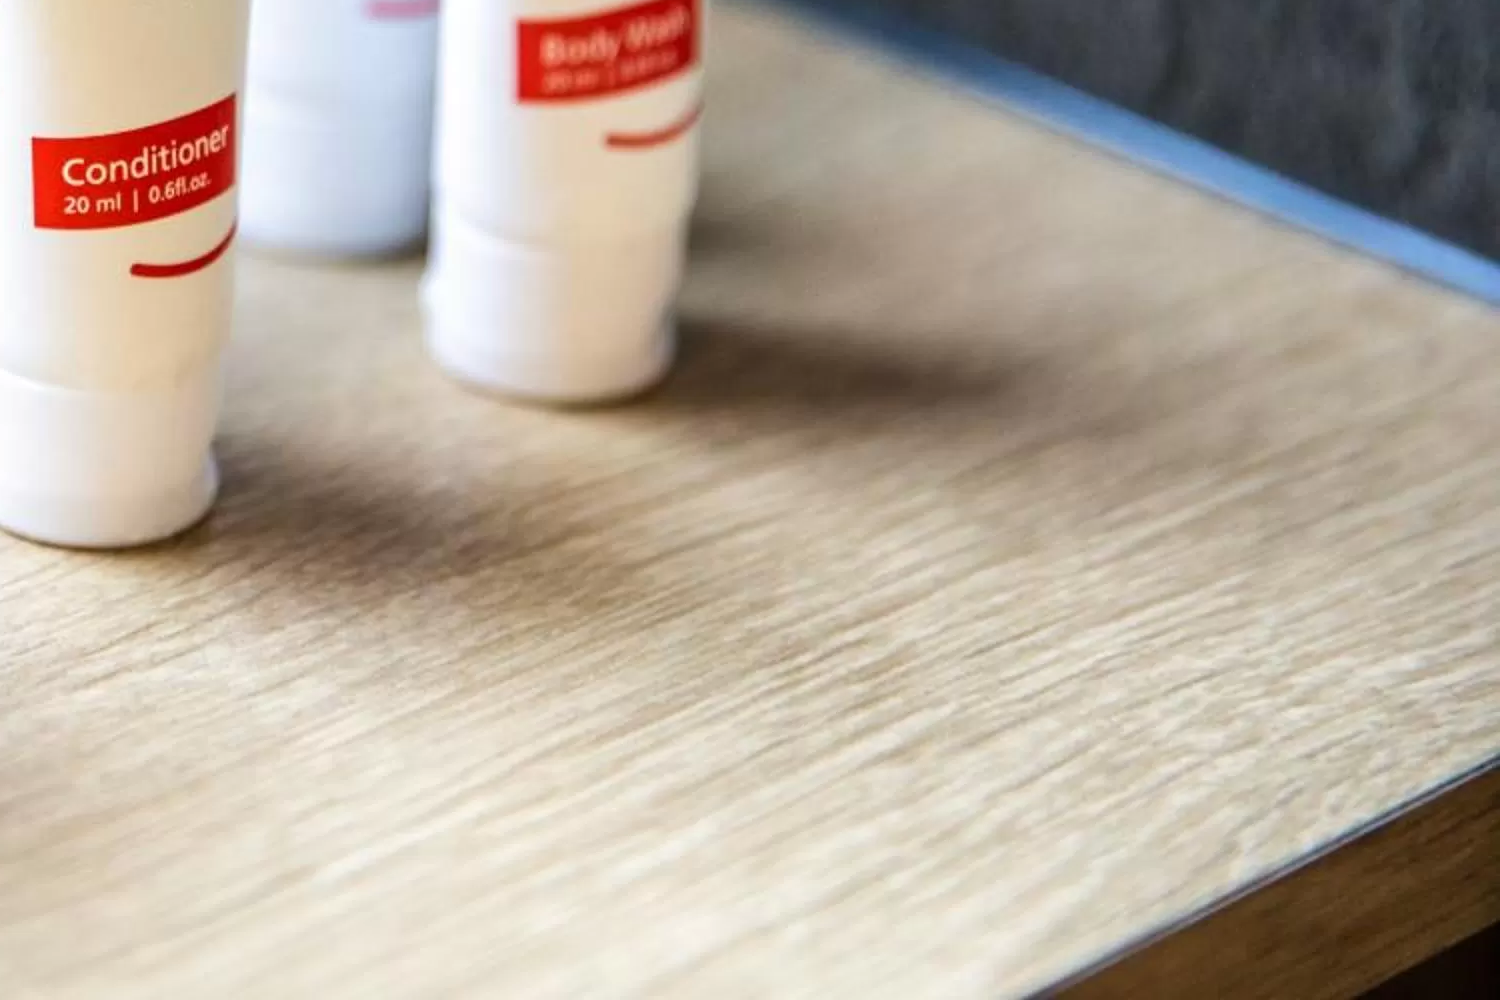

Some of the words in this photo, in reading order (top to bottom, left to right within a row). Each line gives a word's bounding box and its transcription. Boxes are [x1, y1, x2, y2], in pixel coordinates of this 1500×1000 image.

[61, 124, 230, 187] Conditioner
[63, 195, 90, 215] 20
[96, 191, 122, 213] ml
